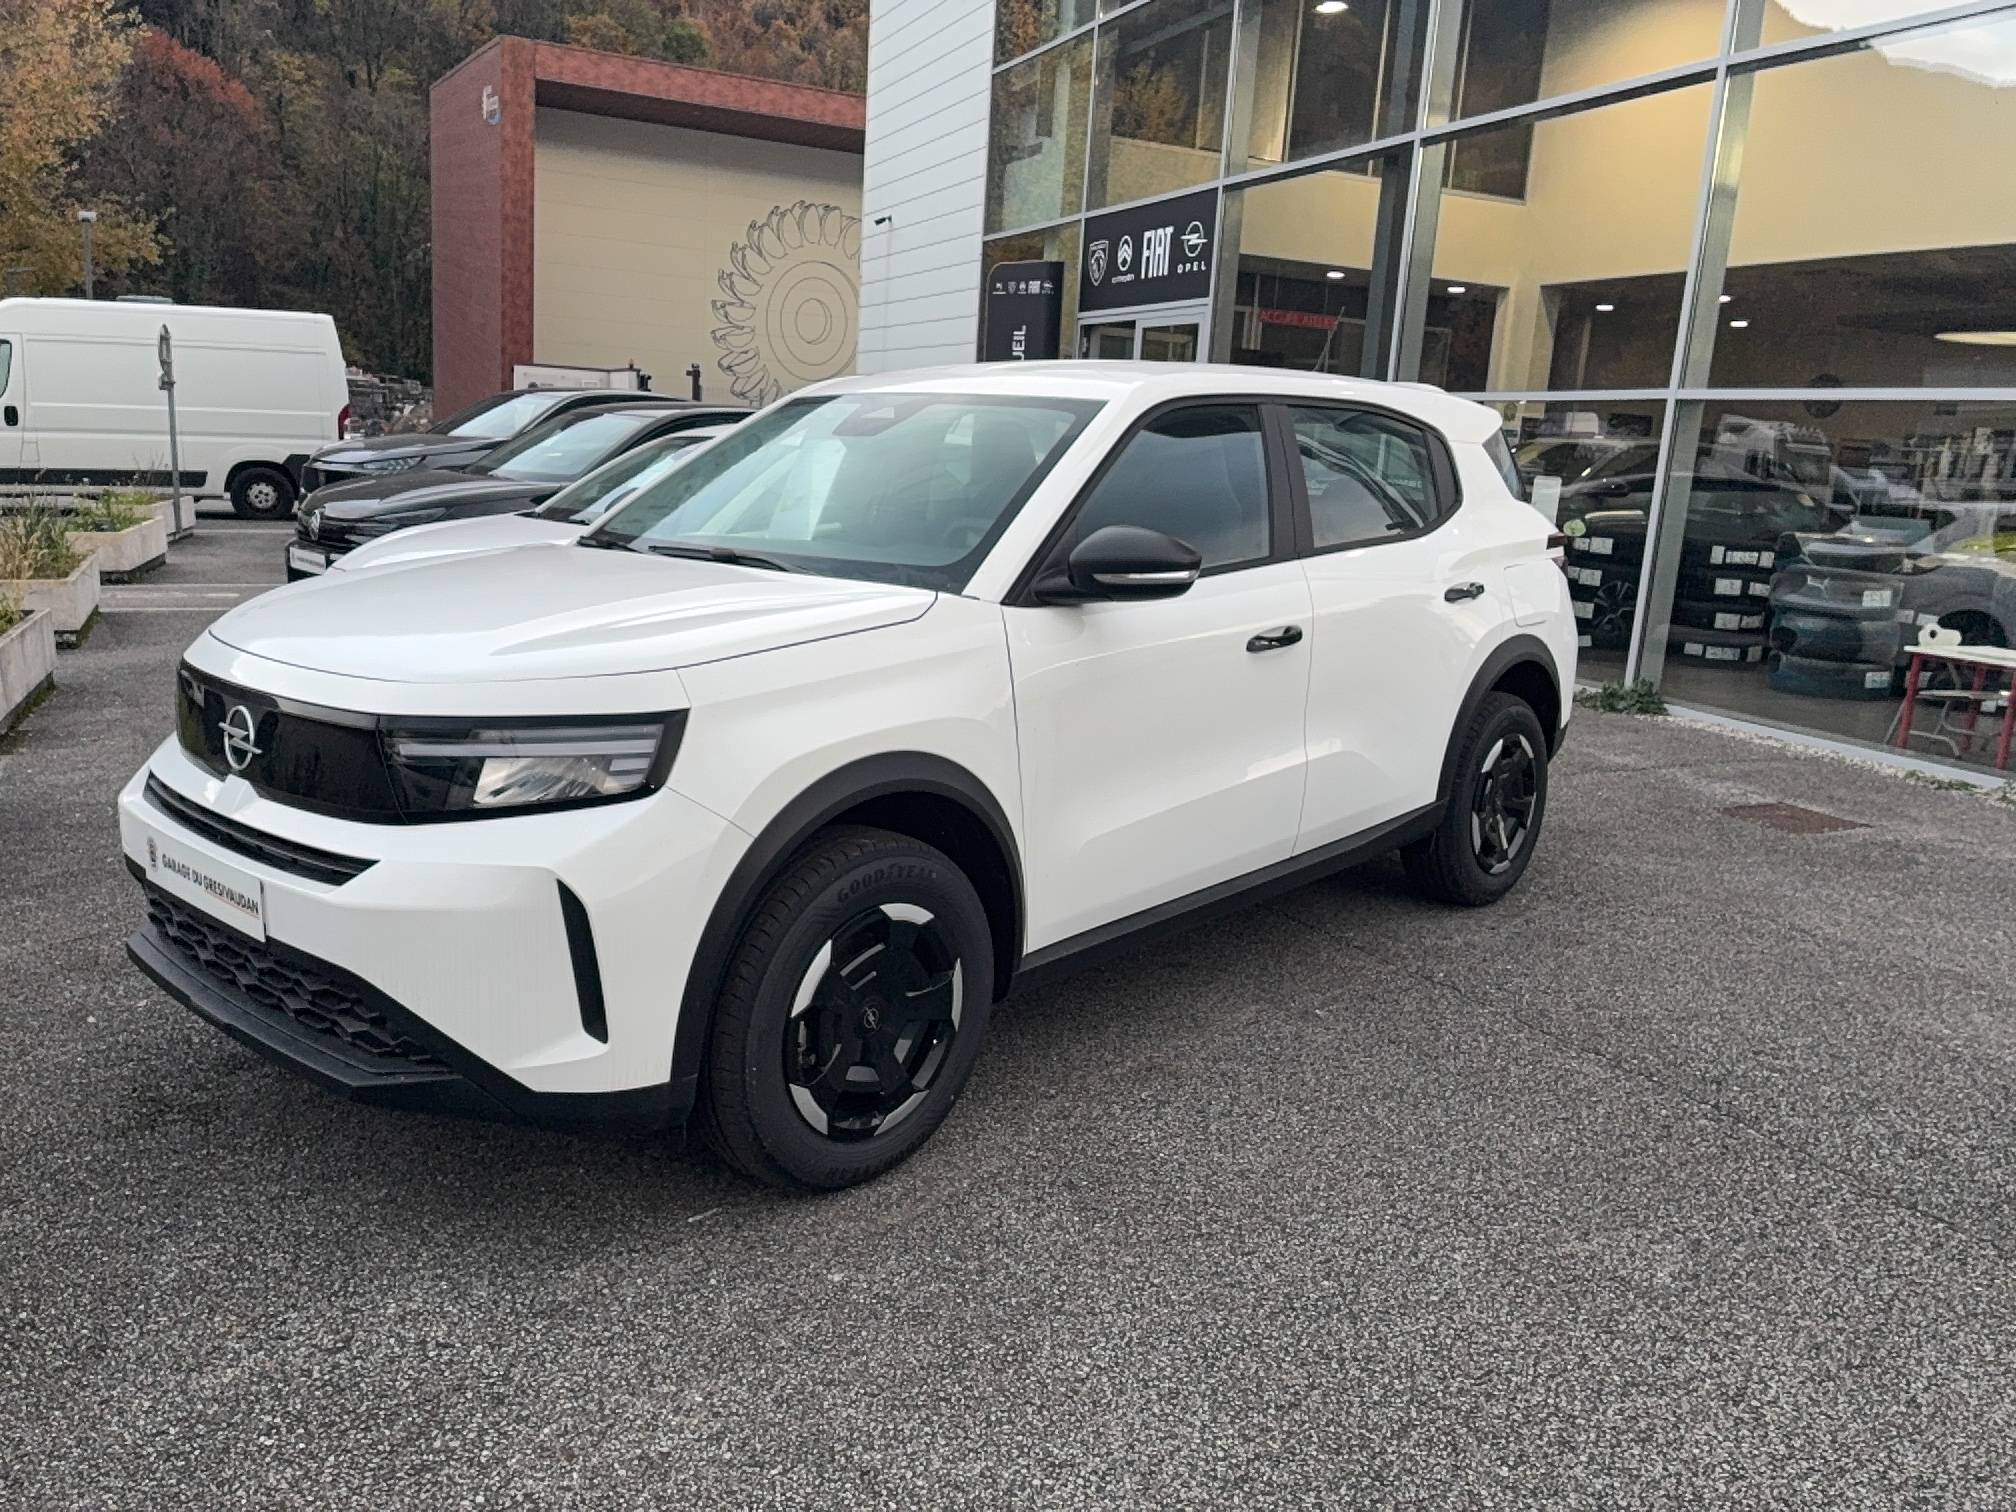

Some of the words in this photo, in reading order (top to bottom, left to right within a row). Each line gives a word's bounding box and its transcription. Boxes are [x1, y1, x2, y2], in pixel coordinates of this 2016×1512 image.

[1142, 226, 1174, 279] FIAT
[1177, 261, 1207, 274] OPEL
[1012, 324, 1026, 360] UEIL
[162, 853, 191, 881] GARAGE
[192, 870, 203, 887] DU
